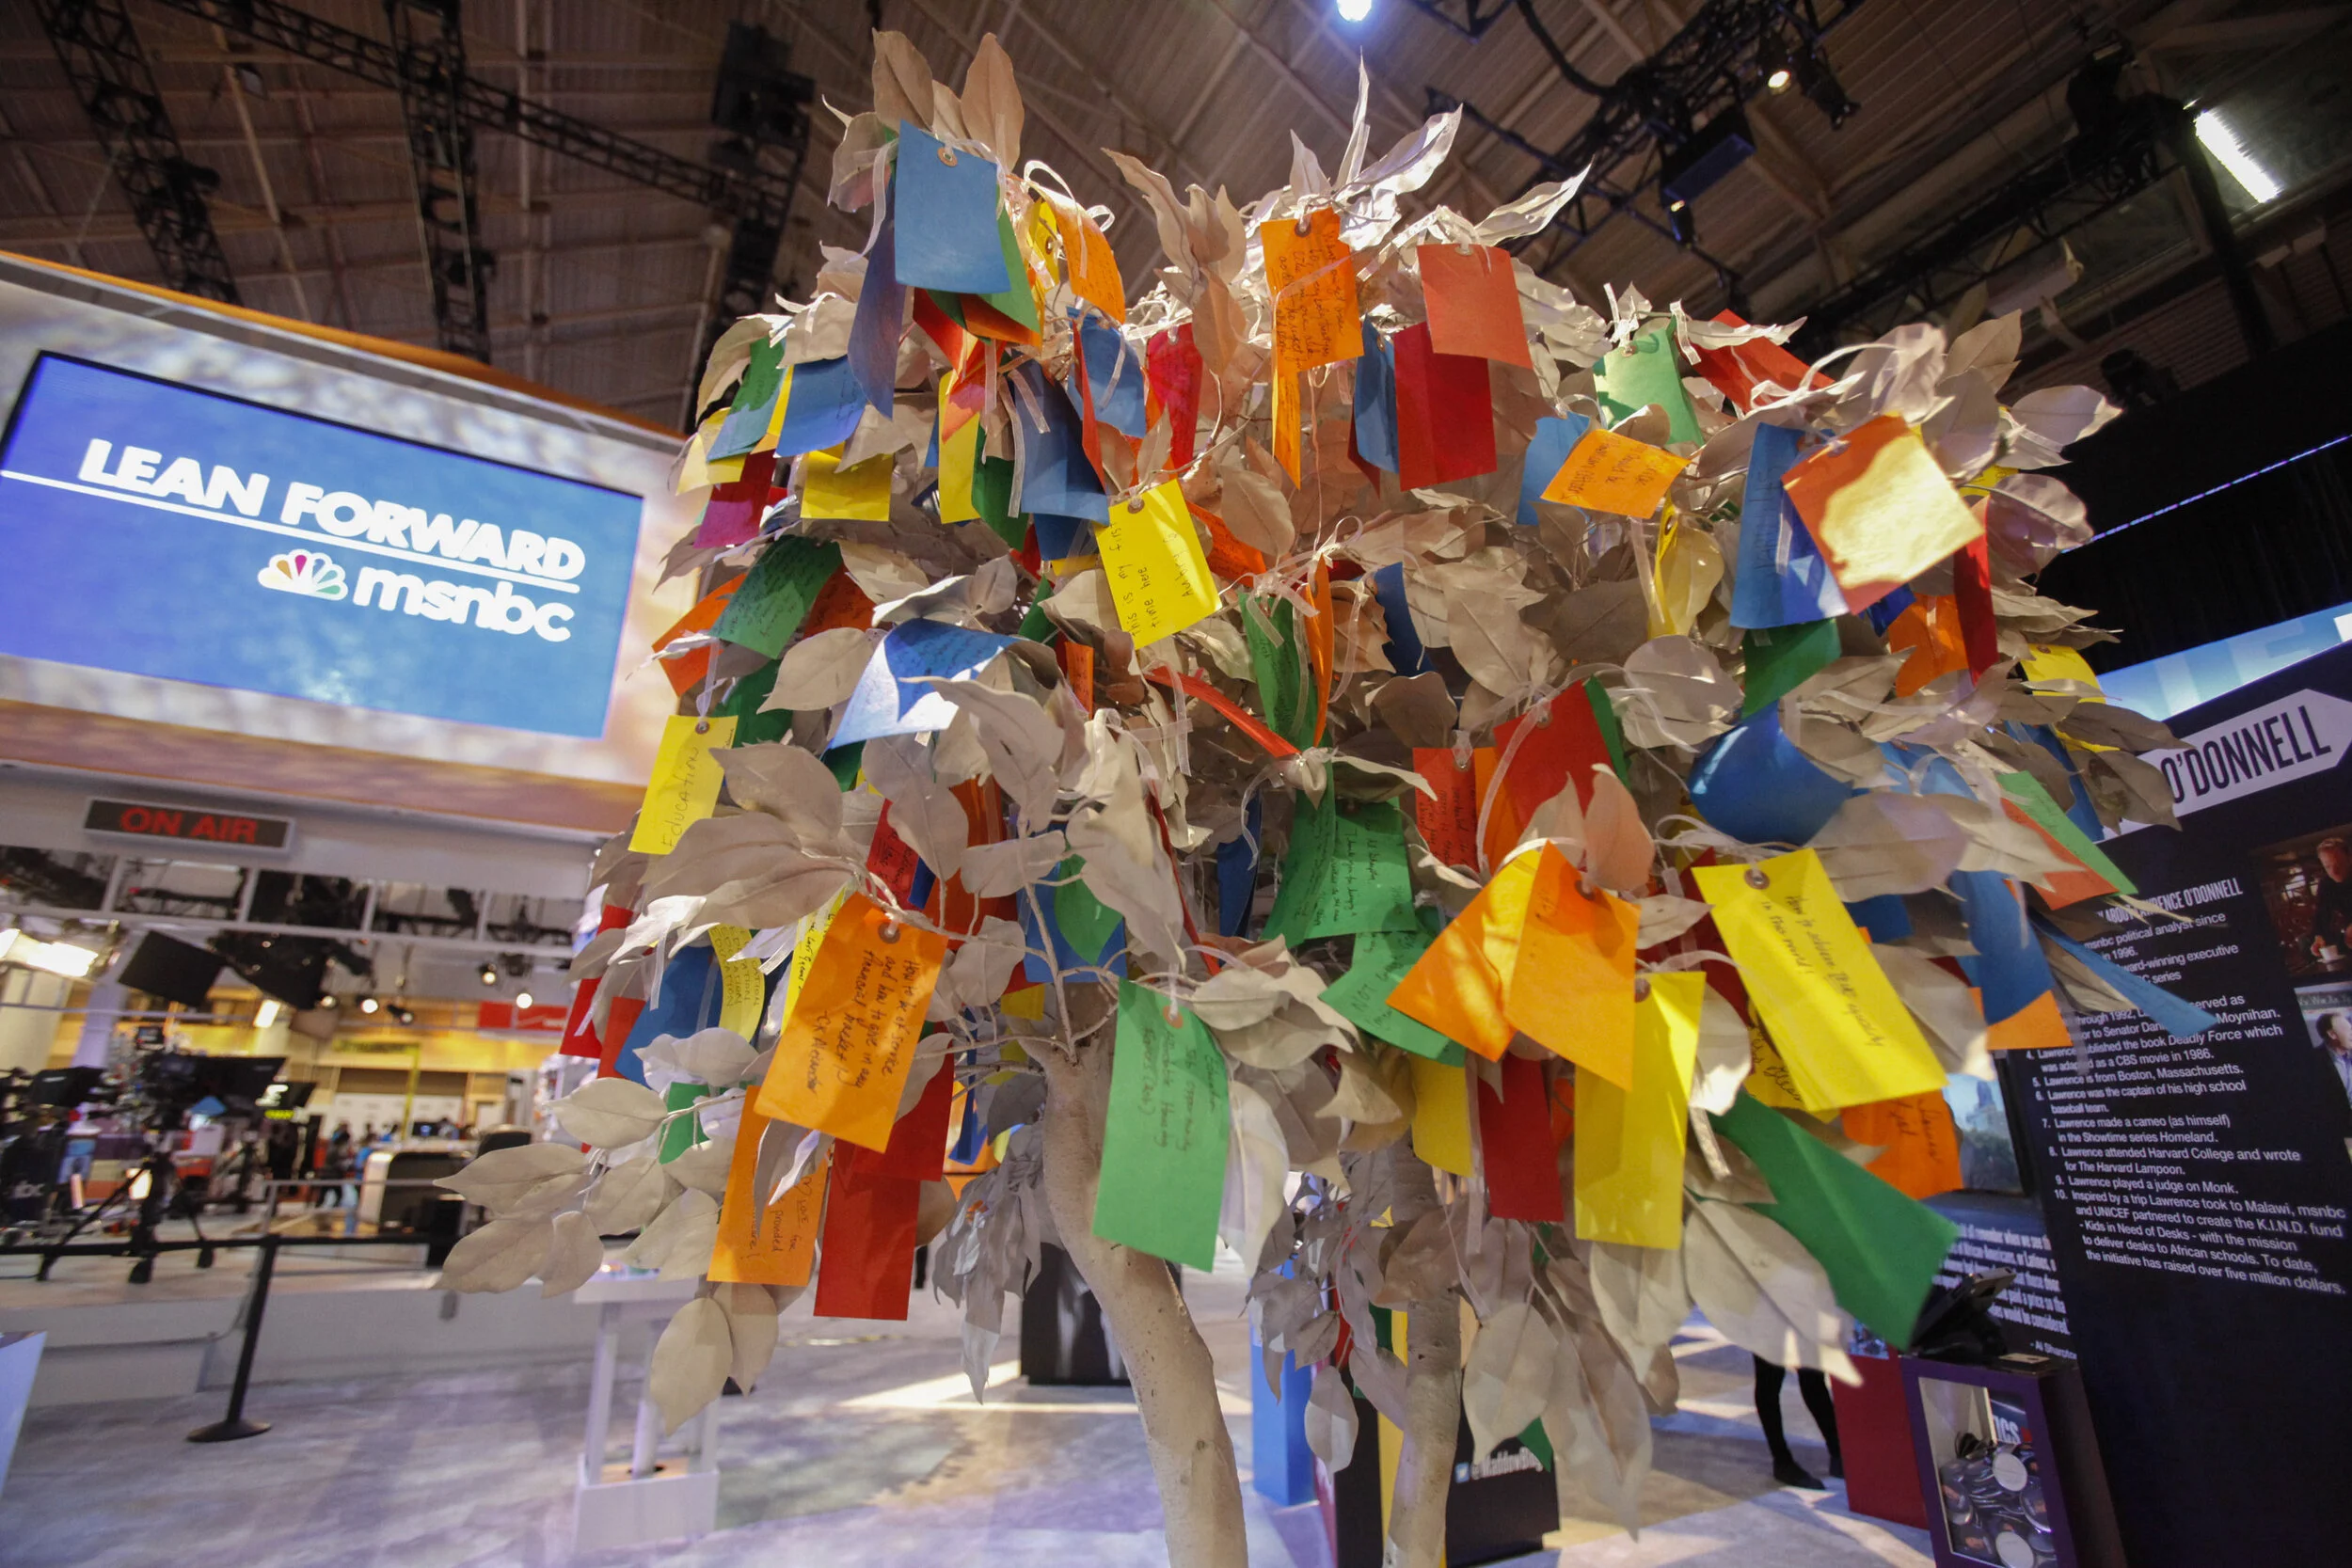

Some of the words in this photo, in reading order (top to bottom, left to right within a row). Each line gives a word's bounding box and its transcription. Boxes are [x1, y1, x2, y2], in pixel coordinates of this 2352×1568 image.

[78, 437, 269, 516] LEAN
[280, 481, 586, 582] FORWARD
[1118, 564, 1133, 578] my
[1138, 567, 1150, 589] here
[353, 566, 575, 643] msnbc
[2160, 705, 2332, 804] O'DONNELL
[119, 807, 183, 837] ON
[188, 814, 259, 845] AIR
[2183, 878, 2244, 907] O'DONNELL
[2115, 927, 2153, 946] political
[2154, 920, 2194, 937] analyst
[2195, 912, 2226, 927] since
[2112, 945, 2138, 960] 1996.
[2120, 952, 2186, 974] ward-winning
[2186, 943, 2239, 961] executive
[2152, 971, 2183, 984] series
[2230, 994, 2246, 1006] as
[2215, 1007, 2281, 1025] Moynihan.
[2103, 1023, 2139, 1037] Senator
[2123, 1039, 2139, 1050] the
[2140, 1036, 2167, 1048] book
[2168, 1032, 2205, 1046] Deadly
[2207, 1028, 2242, 1042] Force
[2244, 1025, 2283, 1038] which
[2095, 1058, 2107, 1068] as
[2116, 1055, 2138, 1066] CBS
[2138, 1053, 2170, 1064] movie
[2171, 1051, 2183, 1061] in
[2183, 1047, 2215, 1061] 1986.
[2094, 1072, 2117, 1083] from
[2117, 1070, 2156, 1082] Boston,
[2156, 1063, 2245, 1079] Massachusetts.
[2106, 1086, 2121, 1098] the
[2121, 1085, 2156, 1098] captain
[2156, 1084, 2166, 1095] of
[2167, 1083, 2184, 1094] his
[2184, 1081, 2207, 1096] high
[2208, 1079, 2247, 1093] school
[2054, 1117, 2096, 1129] Lawrence
[2097, 1117, 2124, 1128] made
[2132, 1117, 2167, 1127] cameo
[2168, 1115, 2185, 1129] (as
[2185, 1113, 2232, 1129] himself)
[2067, 1132, 2082, 1143] the
[2082, 1132, 2128, 1143] Showtime
[2128, 1132, 2159, 1143] series
[2159, 1131, 2219, 1144] Homeland.
[2060, 1147, 2104, 1158] Lawrence
[2105, 1147, 2147, 1159] attended
[2147, 1148, 2189, 1159] Harvard
[2190, 1147, 2234, 1163] College
[2236, 1148, 2261, 1161] and
[2262, 1149, 2301, 1162] wrote
[2078, 1161, 2096, 1172] The
[2096, 1162, 2134, 1174] Harvard
[2135, 1163, 2185, 1177] Lampoon.
[2068, 1175, 2111, 1188] Lawrence
[2112, 1177, 2145, 1191] played
[2146, 1180, 2154, 1190] a
[2154, 1178, 2184, 1194] judge
[2185, 1181, 2201, 1193] on
[2201, 1180, 2239, 1195] Monk.
[2071, 1190, 2108, 1203] Inspired
[2107, 1192, 2121, 1205] by
[2122, 1195, 2130, 1204] a
[2130, 1194, 2148, 1207] trip
[2149, 1194, 2201, 1209] Lawrence
[2201, 1197, 2229, 1212] took
[2230, 1199, 2244, 1212] to
[2244, 1199, 2296, 1217] Malawi,
[2296, 1204, 2347, 1219] msnbc
[2075, 1206, 2093, 1216] and
[2093, 1206, 2130, 1219] UNICEF
[2132, 1210, 2182, 1224] partnered
[2182, 1212, 2195, 1225] to
[2196, 1214, 2233, 1229] create
[2234, 1215, 2255, 1230] the
[2257, 1218, 2308, 1234] K.I.N.D.
[2309, 1222, 2344, 1238] fund
[2107, 1222, 2117, 1232] in
[2117, 1223, 2143, 1236] Need
[2144, 1226, 2155, 1237] of
[2155, 1226, 2190, 1241] Desks
[2199, 1230, 2224, 1244] with
[2225, 1232, 2246, 1246] the
[2247, 1236, 2298, 1252] mission
[2082, 1234, 2093, 1245] to
[2093, 1235, 2124, 1249] deliver
[2125, 1239, 2156, 1253] desks
[2155, 1242, 2169, 1255] to
[2169, 1243, 2209, 1259] African
[2210, 1249, 2260, 1266] schools.
[2261, 1253, 2280, 1268] To
[2281, 1257, 2319, 1274] date,
[2085, 1249, 2102, 1261] the
[2102, 1251, 2142, 1267] initiative
[2143, 1256, 2162, 1270] has
[2163, 1260, 2196, 1275] raised
[2199, 1265, 2223, 1277] over
[2224, 1266, 2248, 1281] five
[2249, 1271, 2292, 1288] million
[2293, 1276, 2346, 1295] dollars.
